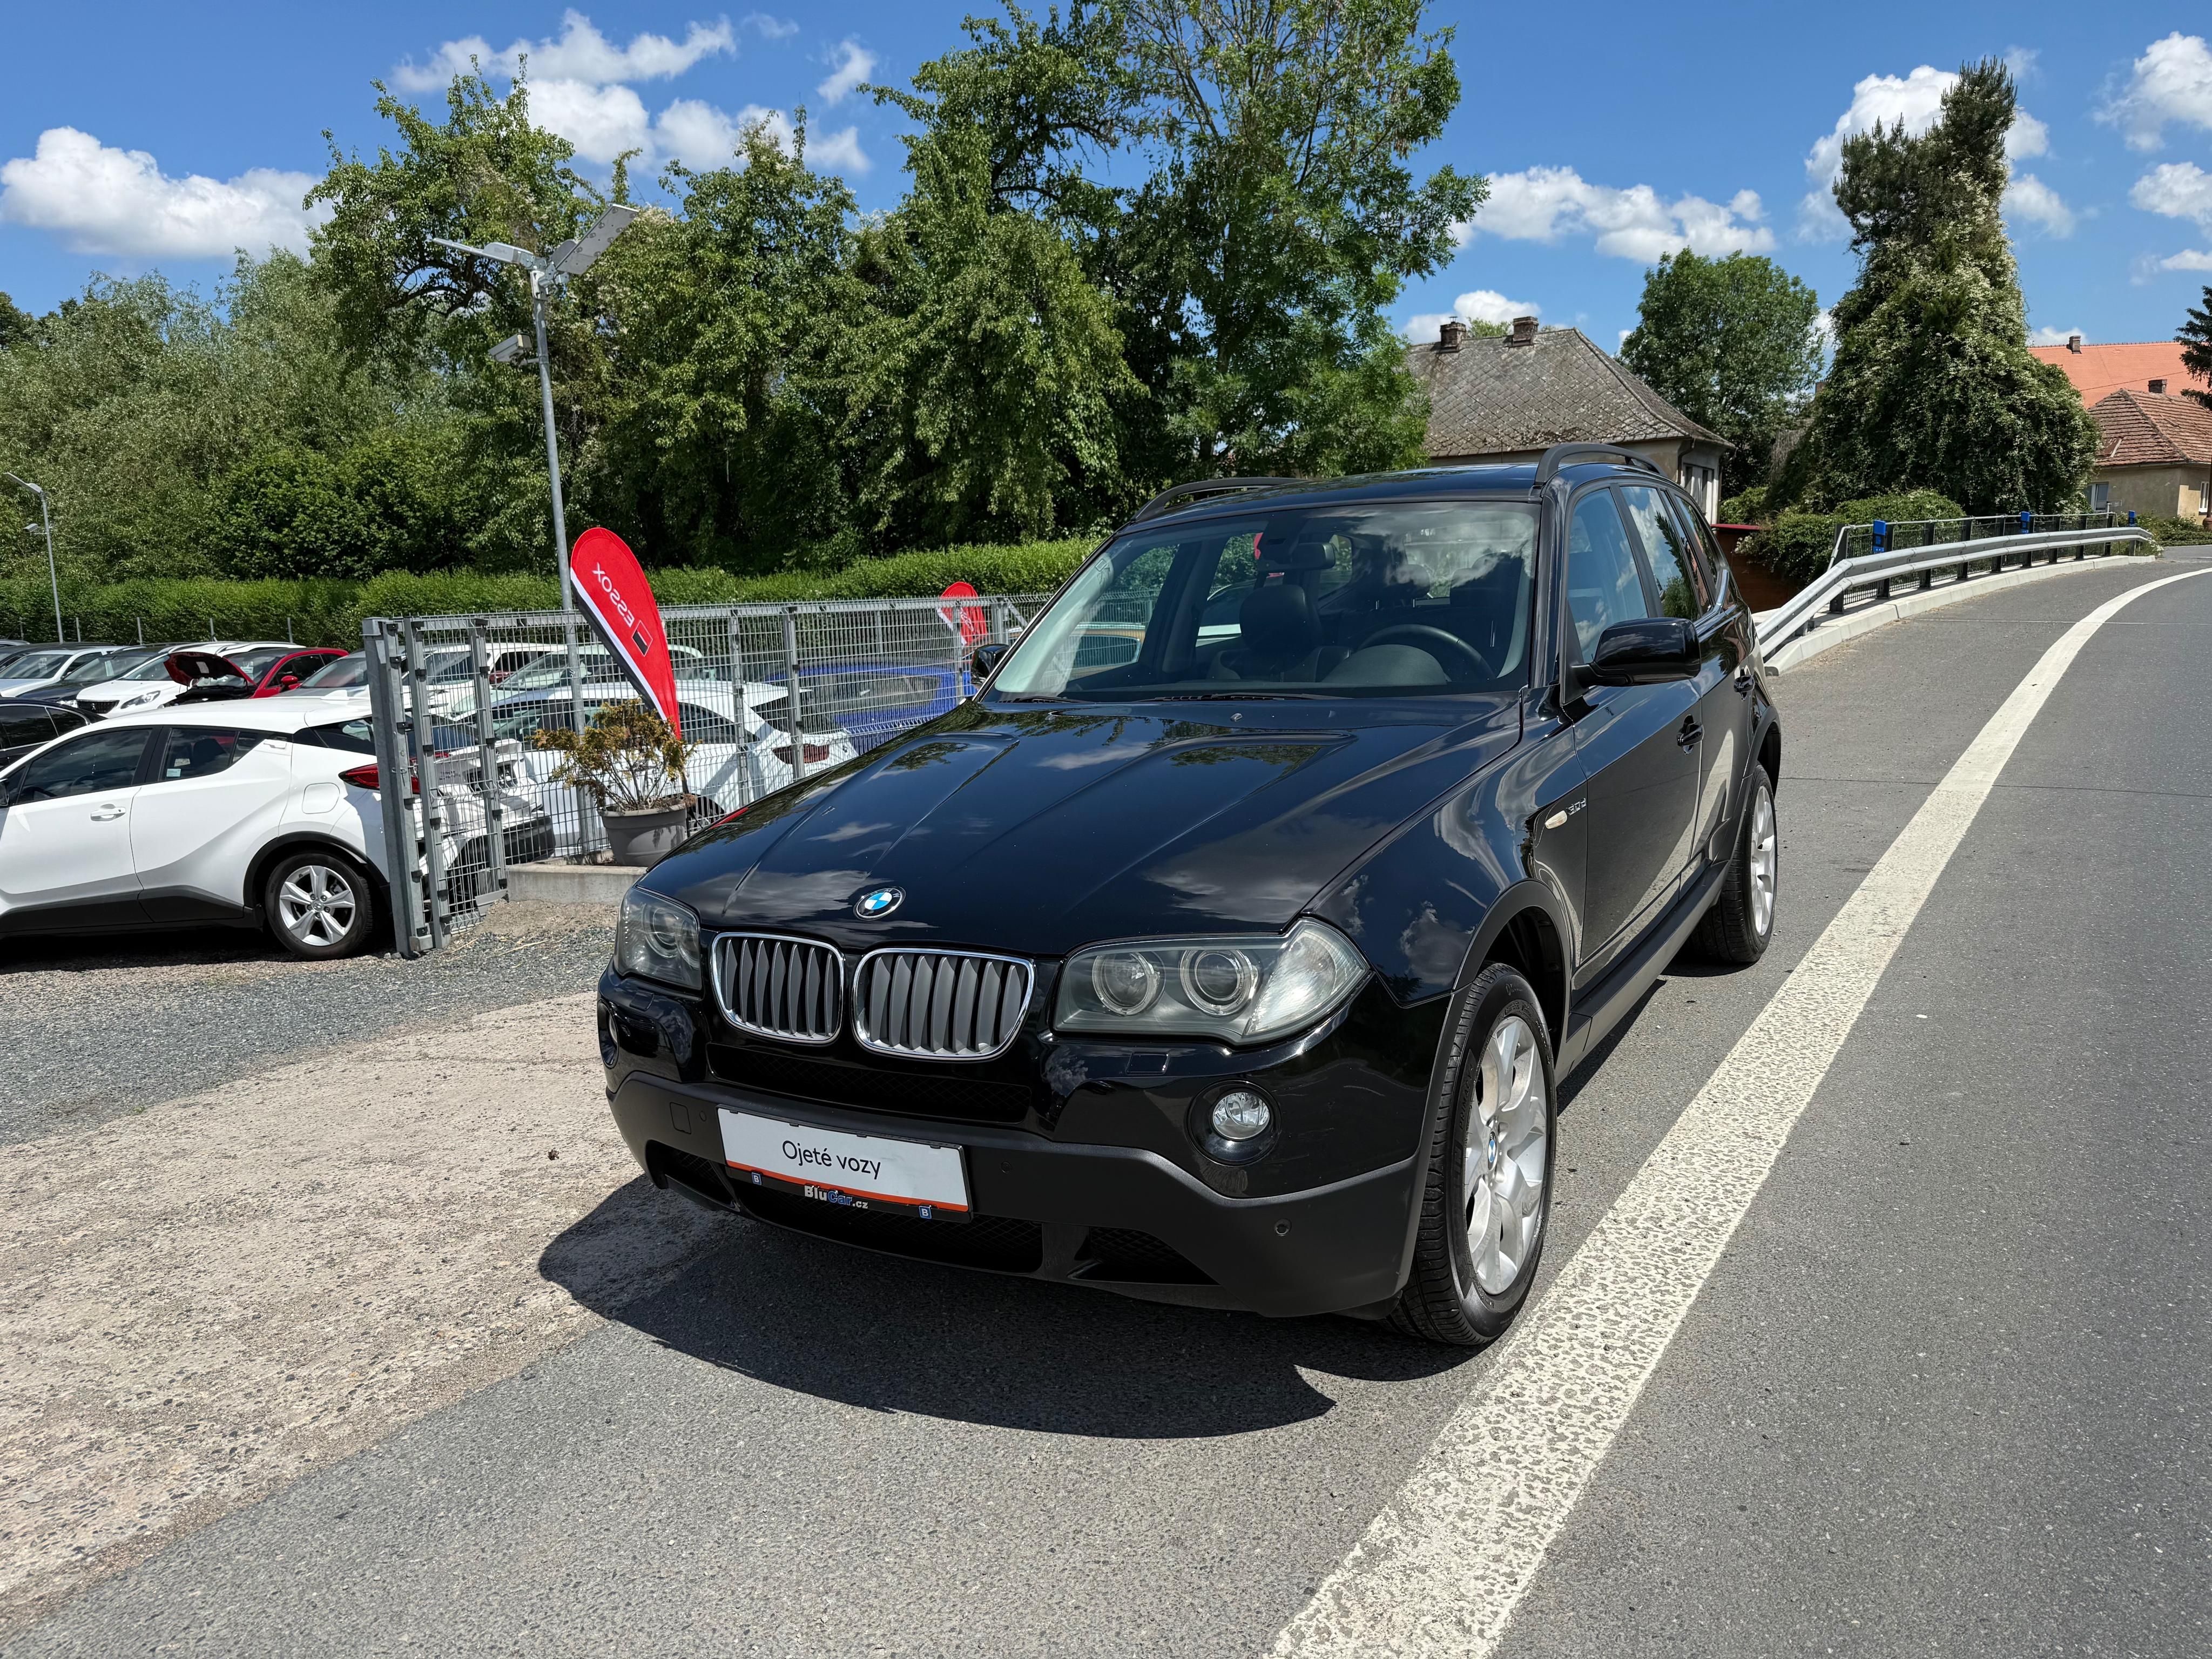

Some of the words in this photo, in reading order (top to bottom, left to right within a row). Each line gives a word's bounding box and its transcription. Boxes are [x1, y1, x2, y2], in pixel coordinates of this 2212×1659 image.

[783, 1140, 832, 1167] Ojeté
[837, 1155, 881, 1180] vozy
[753, 1175, 759, 1183] B
[804, 1185, 868, 1209] BluCar.cz
[921, 1208, 929, 1216] B
